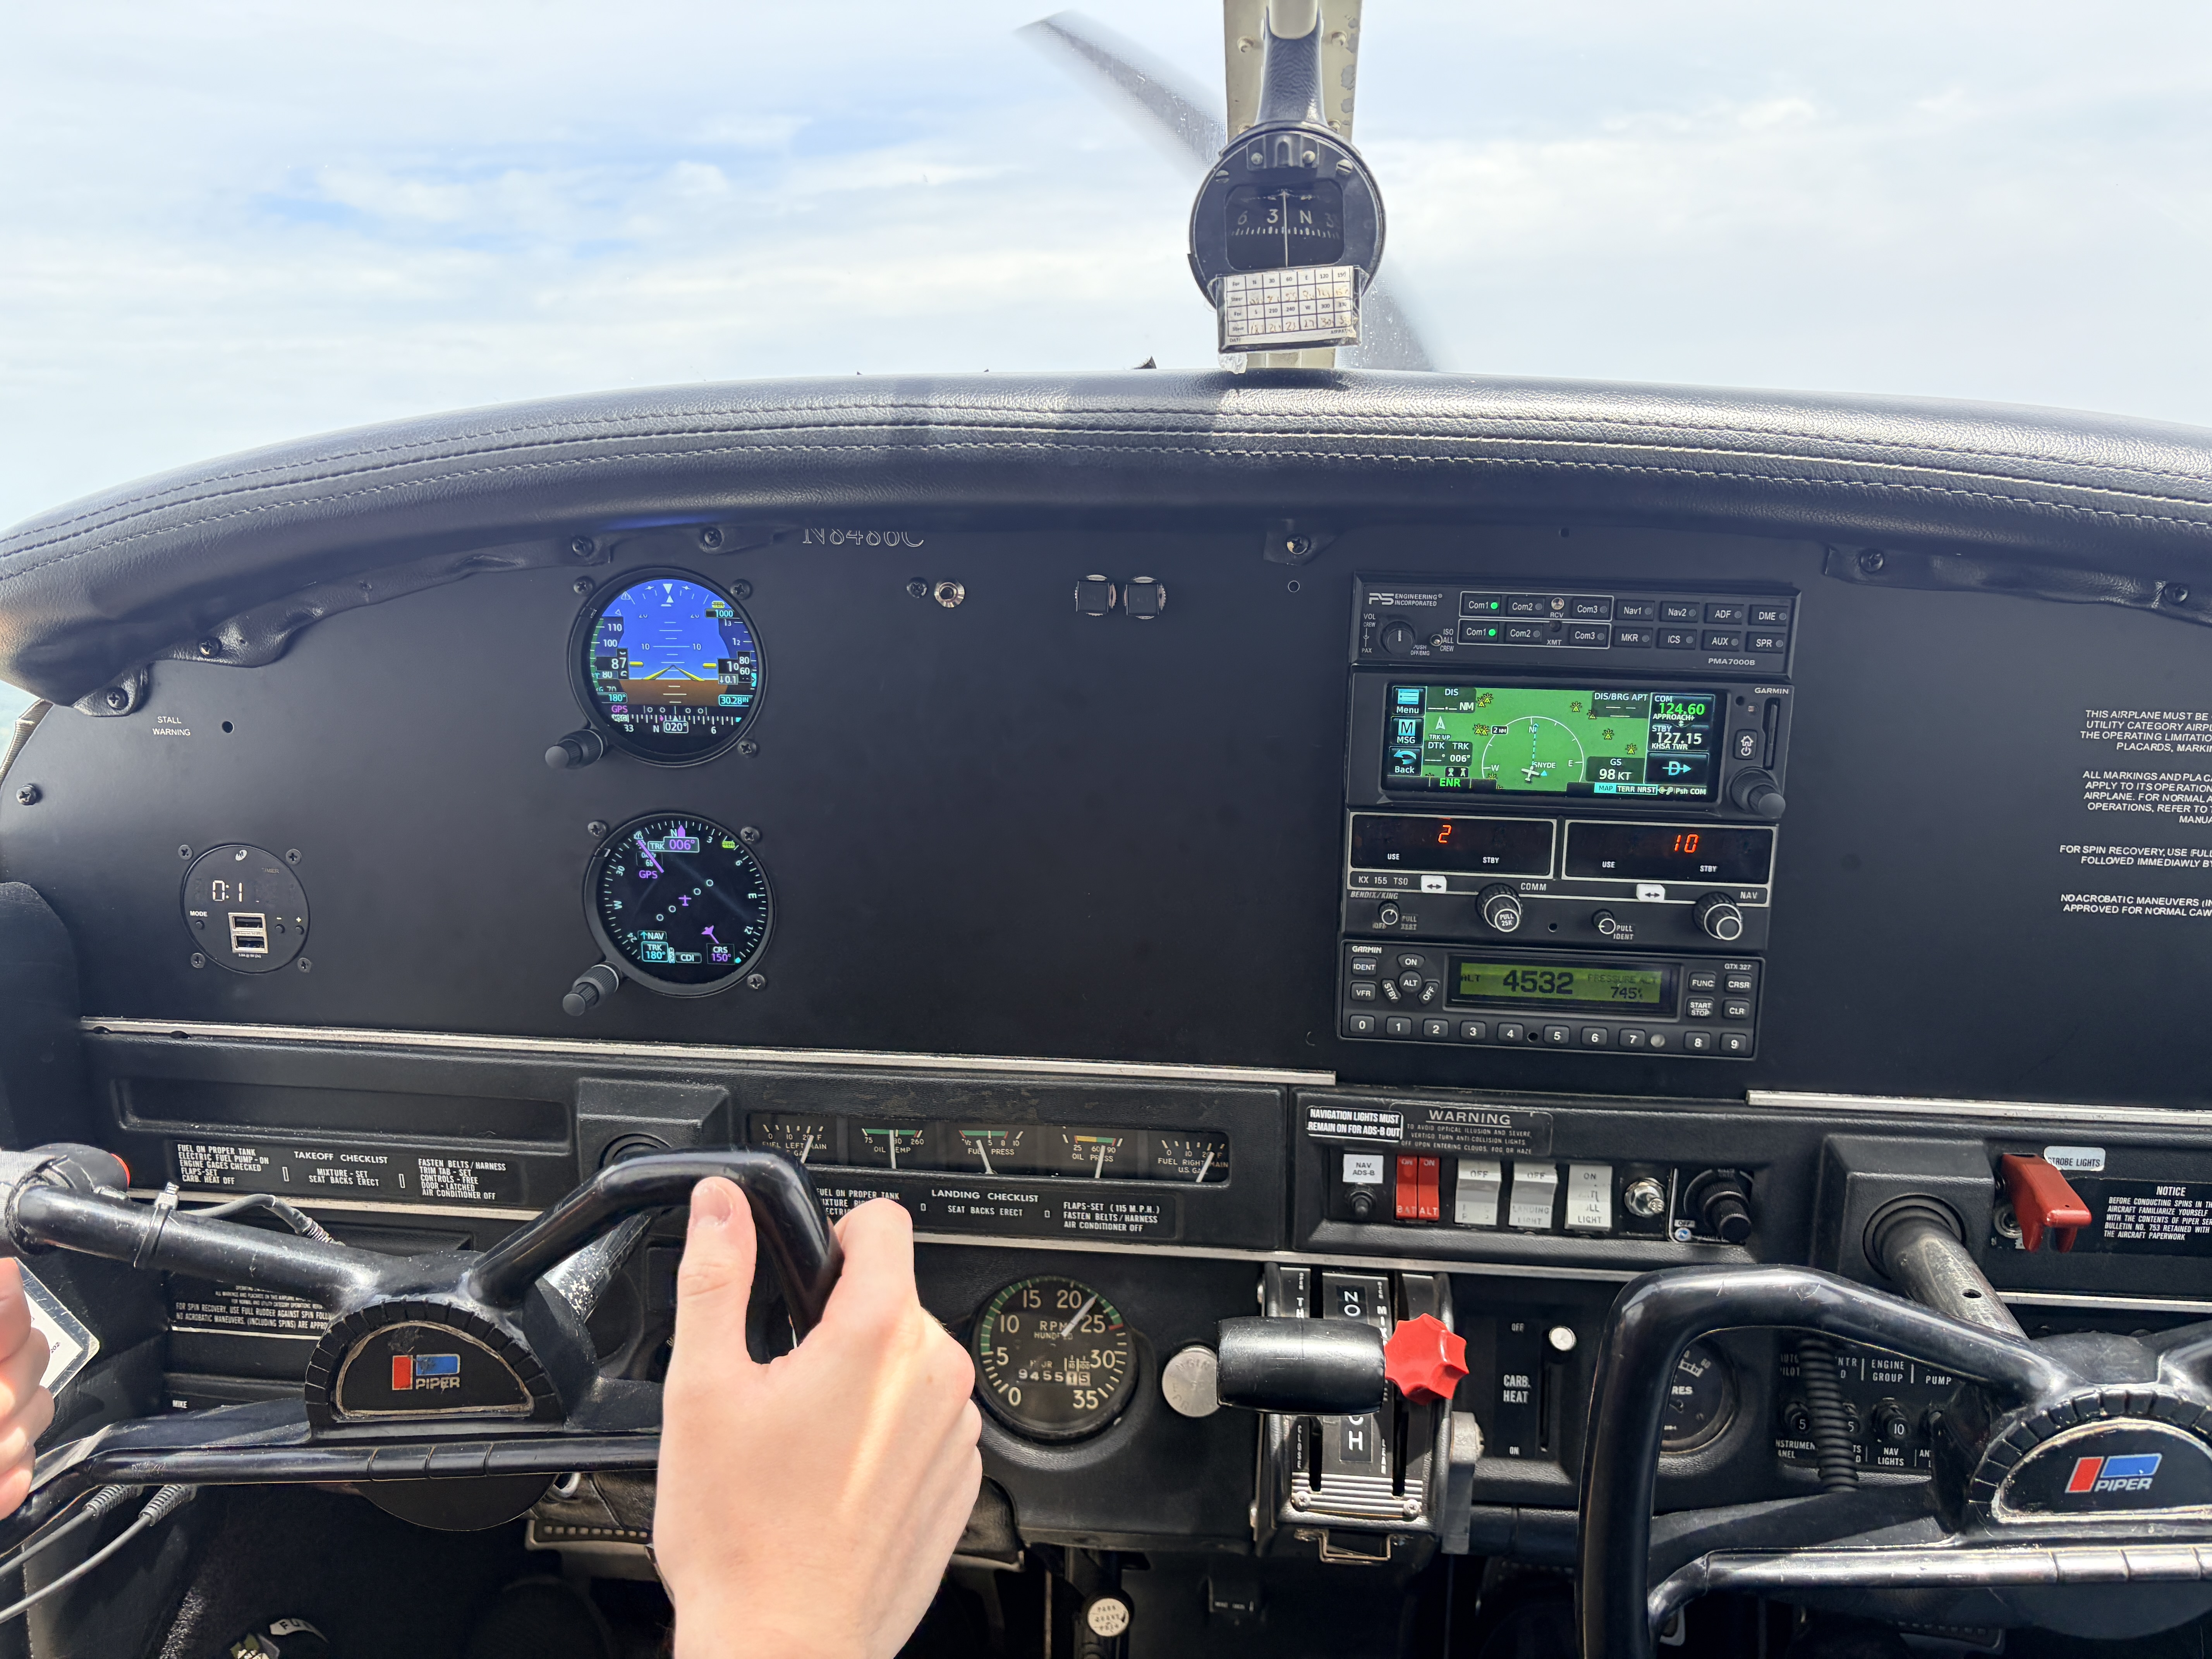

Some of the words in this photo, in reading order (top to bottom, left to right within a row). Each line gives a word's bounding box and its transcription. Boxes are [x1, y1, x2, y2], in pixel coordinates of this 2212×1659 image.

[1267, 209, 1278, 223] 3
[1300, 210, 1312, 224] N
[1577, 605, 1597, 613] Com3
[1668, 608, 1686, 617] Nav2
[1460, 702, 1474, 711] NM
[1659, 703, 1705, 715] 124.60
[2086, 710, 2108, 718] THIS
[2110, 711, 2160, 719] AIRPLANE
[2195, 713, 2209, 721] BE
[2086, 721, 2124, 729] UTILITY
[2127, 721, 2183, 730] CATEGORY
[1657, 732, 1702, 745] 127.15
[2080, 731, 2100, 739] THE
[2102, 732, 2162, 741] OPERATING
[2117, 742, 2173, 752] PLACARDS,
[1599, 769, 1615, 780] 98
[1618, 772, 1632, 780] KT
[1439, 779, 1461, 787] ENR
[2157, 804, 2190, 813] REFER
[1438, 825, 1452, 843] 2
[1674, 834, 1698, 853] 10
[2083, 846, 2106, 854] SPIN
[2081, 856, 2133, 865] FOLLOWED
[2138, 858, 2200, 867] IMMEDIAWLY
[639, 871, 658, 879] GPS
[2136, 897, 2199, 906] MANEUVERS
[2063, 904, 2119, 913] APPROVED
[2122, 906, 2142, 914] FOR
[2145, 907, 2186, 916] NORMAL
[1503, 969, 1573, 995] 4532
[1384, 983, 1398, 1001] STBY
[1423, 986, 1434, 1000] OFF
[1359, 1021, 1366, 1029] 0
[1310, 1109, 1352, 1120] NAVIGATION
[1353, 1112, 1378, 1122] LIGHTS
[1379, 1113, 1400, 1124] MUST
[1429, 1110, 1511, 1125] WARNING
[1308, 1121, 1336, 1132] REMAIN
[1363, 1126, 1385, 1135] ADS-B
[178, 1144, 194, 1152] FUEL
[208, 1146, 235, 1154] PROPER
[294, 1151, 333, 1160] TAKEOFF
[340, 1154, 388, 1164] CHECKLIST
[418, 1159, 443, 1167] FASTEN
[2076, 1158, 2100, 1167] LIGHTS
[179, 1159, 204, 1168] ENGINE
[207, 1161, 228, 1170] GAGES
[230, 1163, 261, 1171] CHECKED
[421, 1175, 454, 1183] CONTROLS
[436, 1190, 481, 1199] CONDITIONER
[931, 1189, 980, 1199] LANDING
[988, 1193, 1038, 1202] CHECKLIST
[2156, 1186, 2186, 1196] NOTICE
[2134, 1198, 2171, 1206] CONDUCTING
[1419, 1207, 1438, 1216] ALT
[2148, 1232, 2185, 1240] PAPERWORK
[1023, 1290, 1041, 1308] 15
[1057, 1290, 1082, 1309] 20
[1000, 1314, 1019, 1333] 10
[997, 1347, 1009, 1365] 5
[1091, 1350, 1116, 1369] 30
[1872, 1358, 1905, 1370] ENGINE
[415, 1376, 460, 1389] PIPER
[1503, 1375, 1530, 1387] CARB.
[1872, 1372, 1903, 1383] GROUP
[1073, 1390, 1099, 1410] 35
[1503, 1390, 1528, 1403] HEAT
[2095, 1478, 2153, 1492] PIPER
